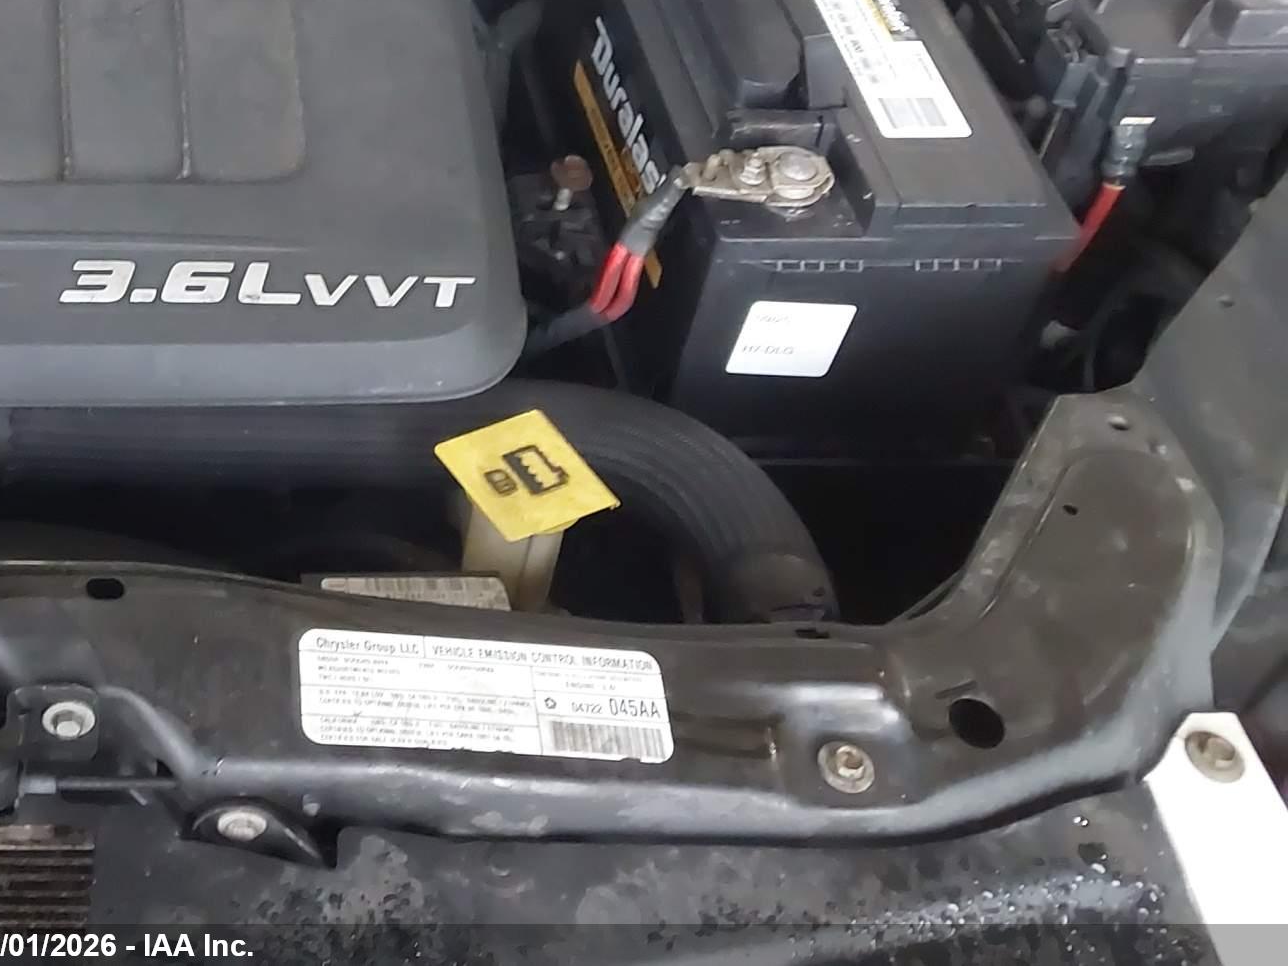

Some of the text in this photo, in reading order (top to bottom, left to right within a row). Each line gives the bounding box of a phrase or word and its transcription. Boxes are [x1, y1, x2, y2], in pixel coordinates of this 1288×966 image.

[316, 636, 361, 652] Chrysler
[364, 639, 396, 654] Group
[431, 644, 653, 671] VEHICLE EMISSION CONTROL INFORMATION
[608, 697, 662, 719] 045AA
